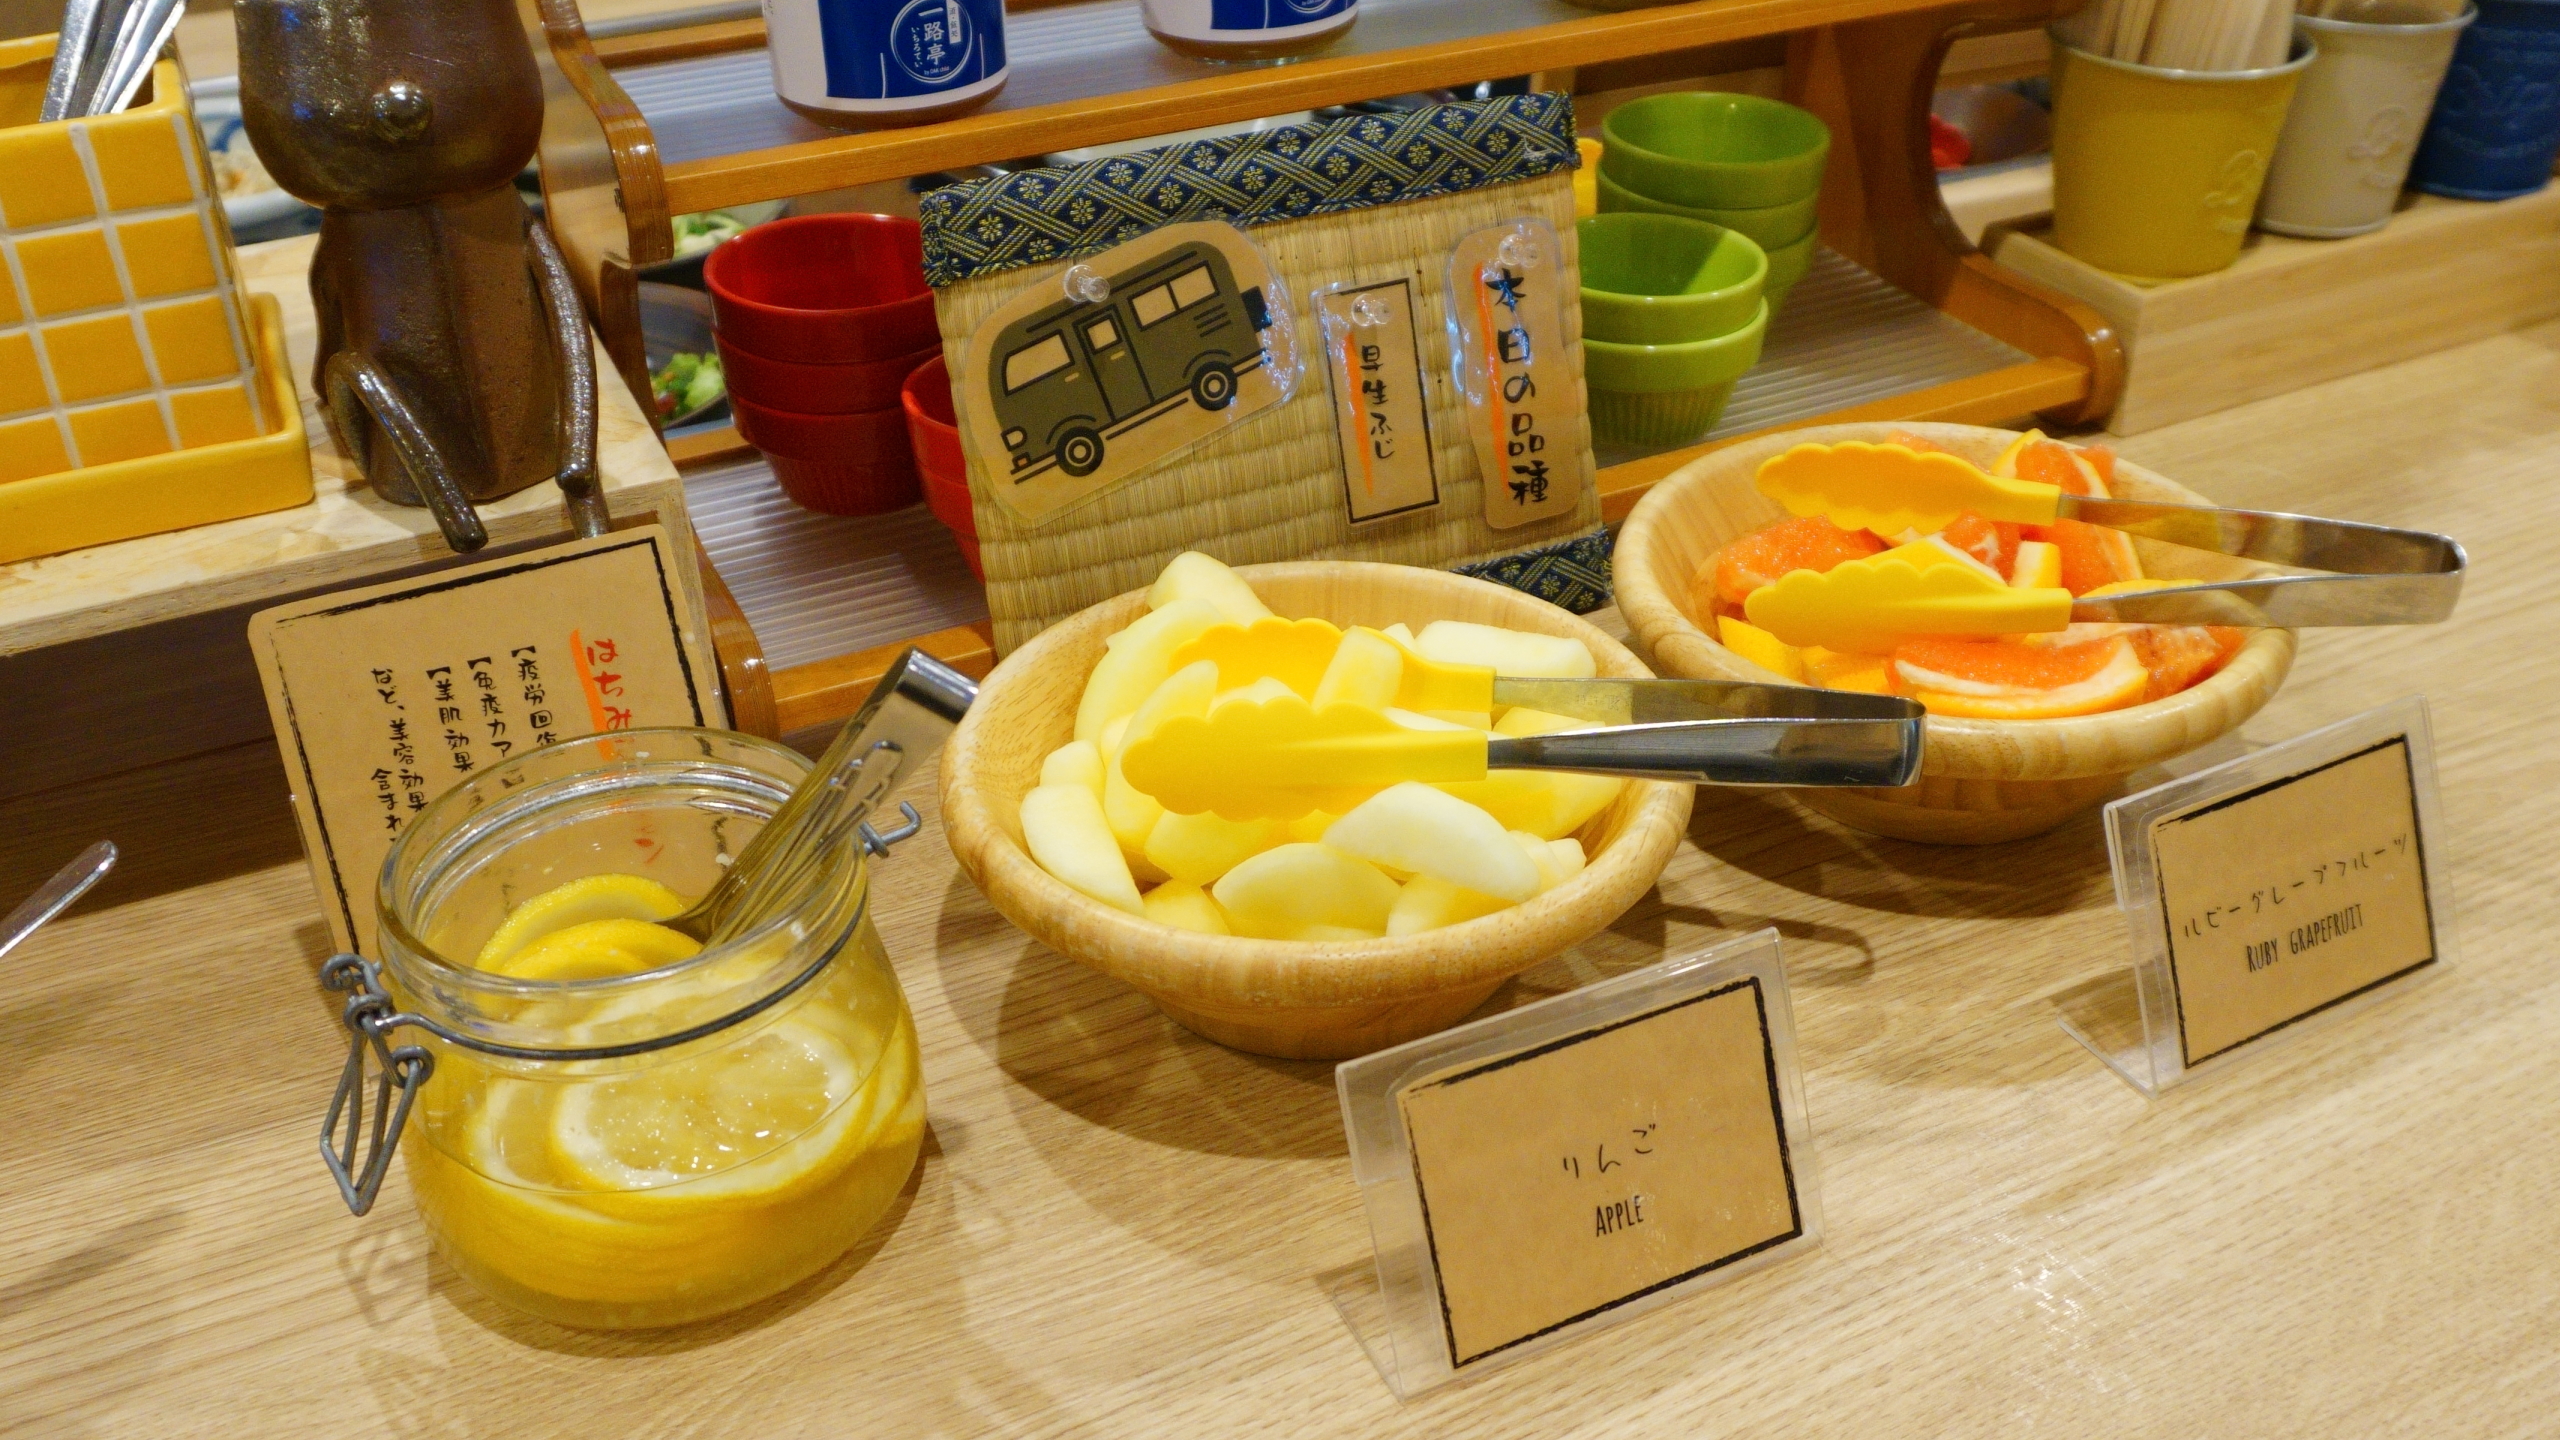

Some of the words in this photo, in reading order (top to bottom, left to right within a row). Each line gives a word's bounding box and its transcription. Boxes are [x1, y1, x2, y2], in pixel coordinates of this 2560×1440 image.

[911, 27, 923, 68] いちろてい
[918, 7, 945, 65] 一路亭
[1360, 345, 1395, 459] 早生ふじ
[1486, 268, 1549, 505] 本日の品種
[2184, 833, 2407, 938] ルビーグレープフルーツ
[2246, 938, 2279, 973] RUBY
[2290, 903, 2364, 955] GRAPEFRUIT
[1563, 1123, 1656, 1179] りんご
[1596, 1195, 1644, 1238] APPLE
